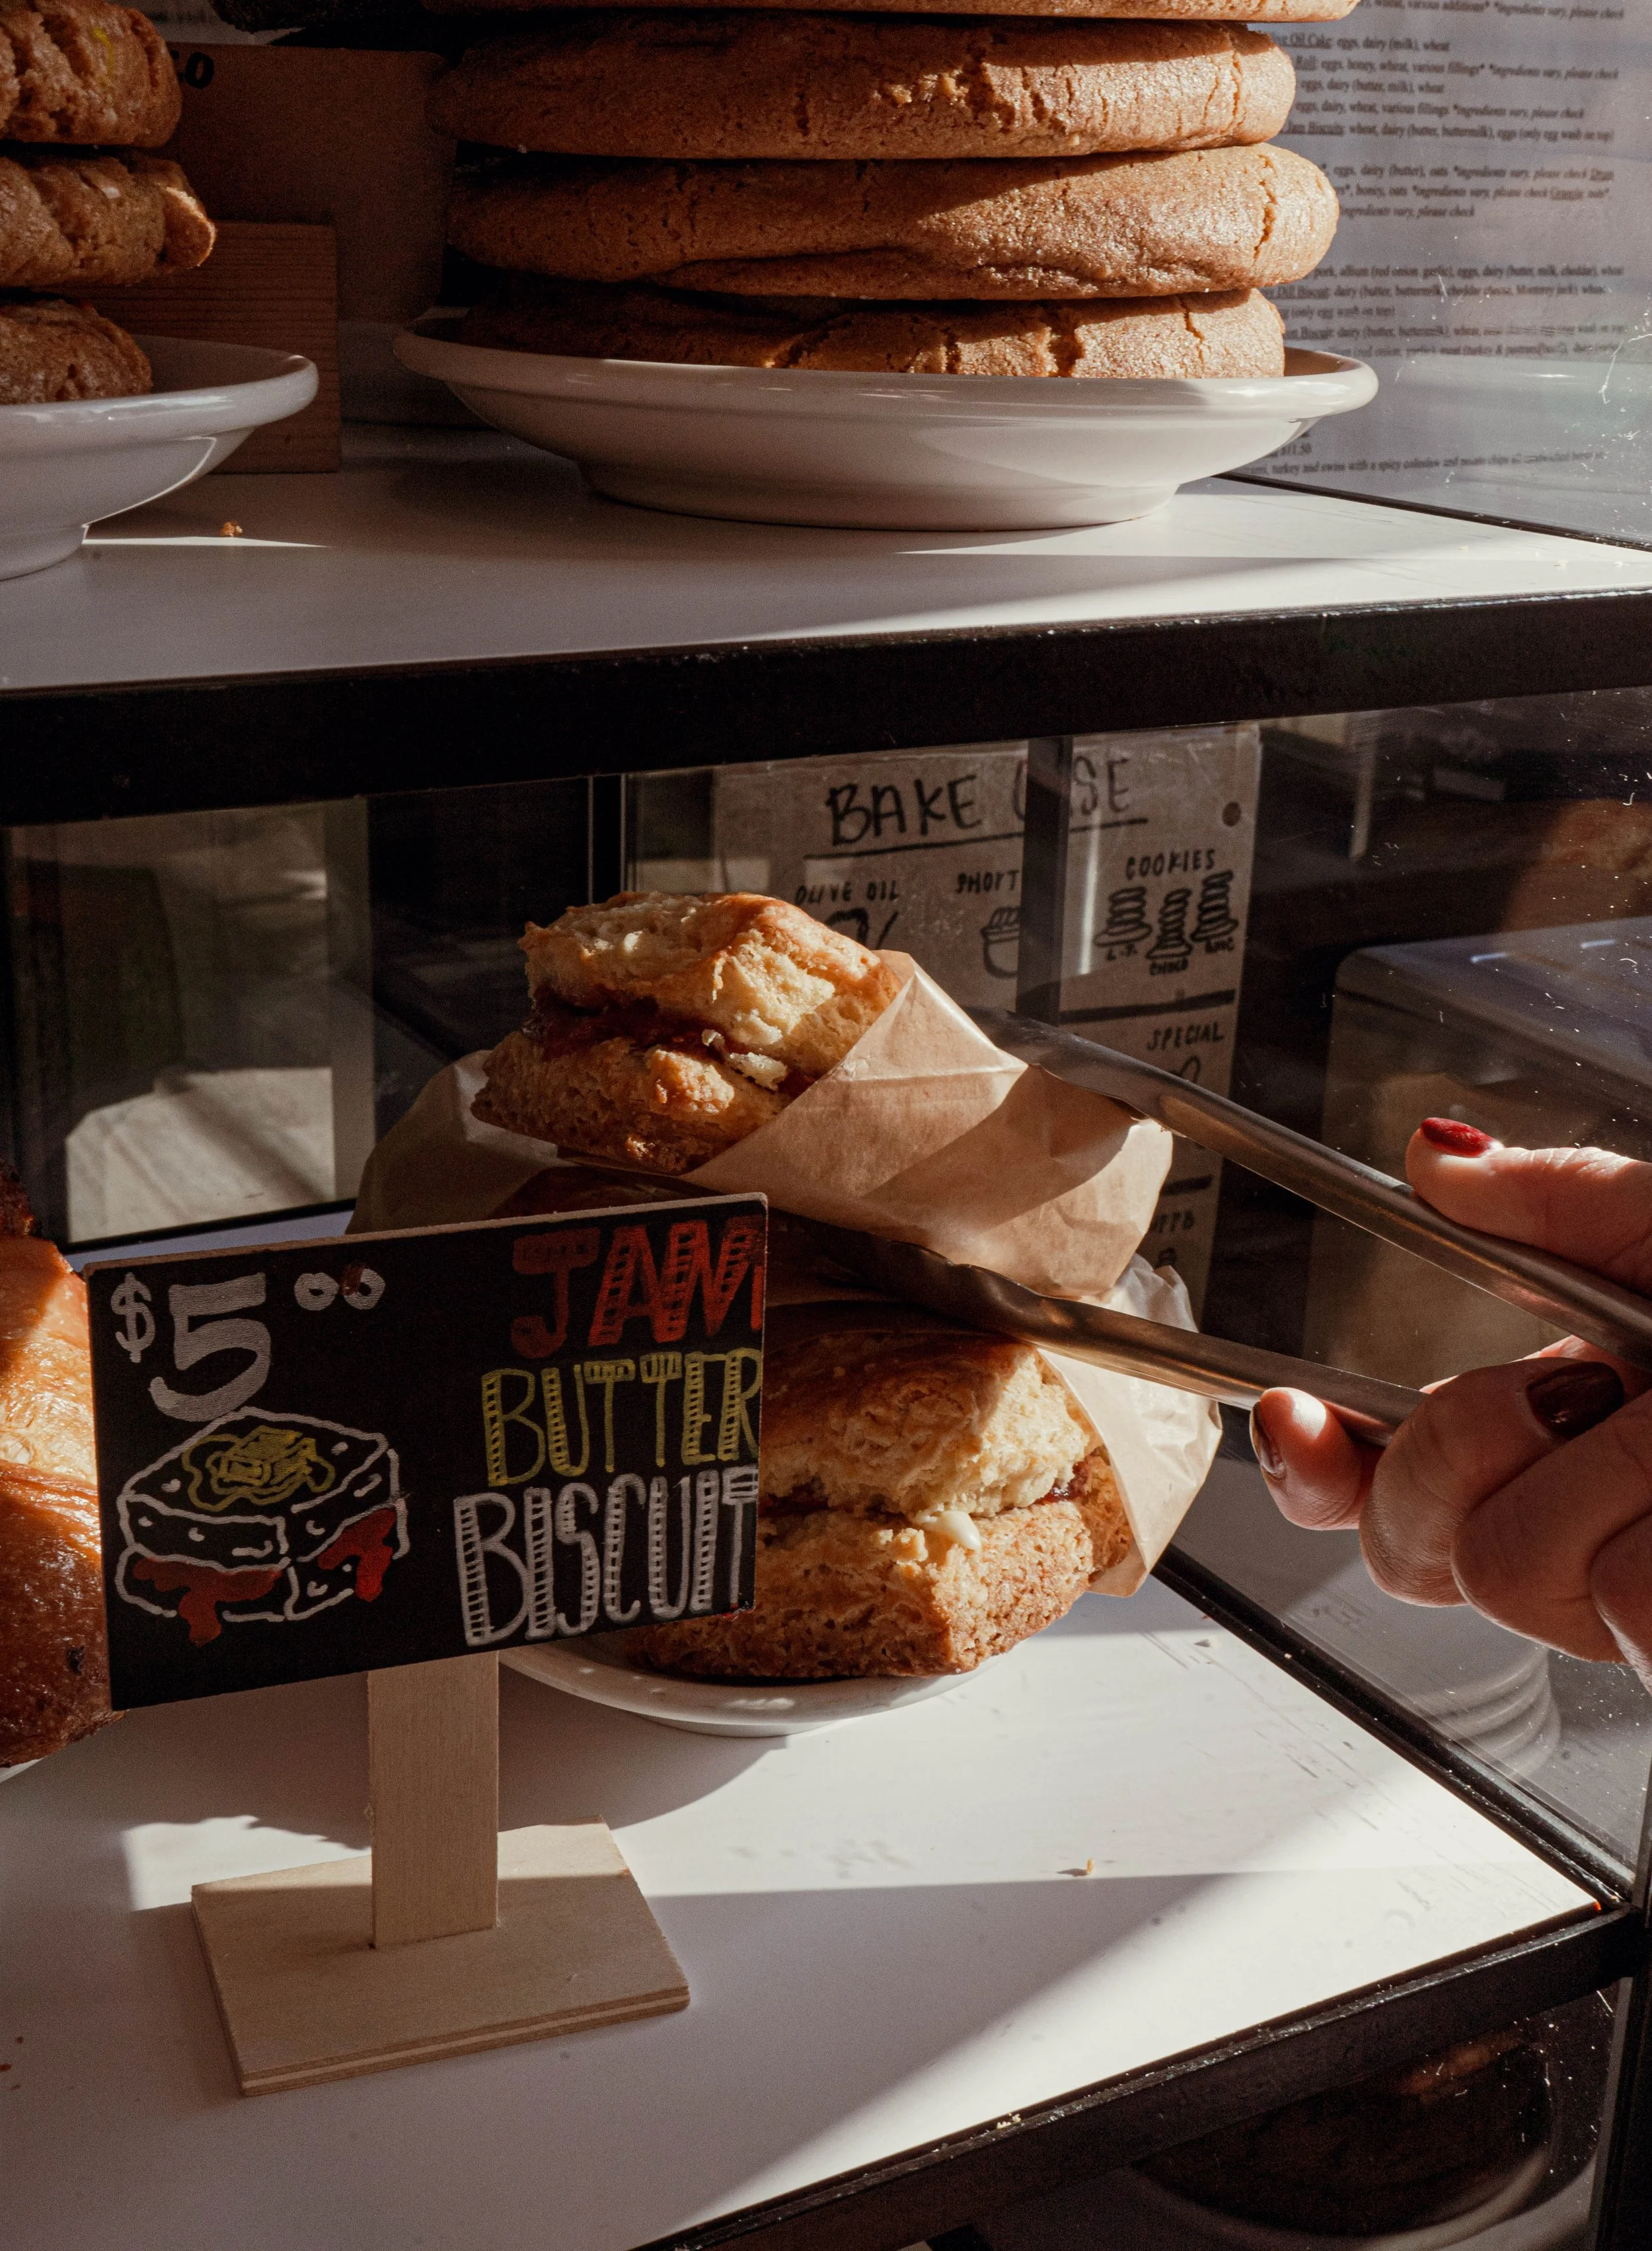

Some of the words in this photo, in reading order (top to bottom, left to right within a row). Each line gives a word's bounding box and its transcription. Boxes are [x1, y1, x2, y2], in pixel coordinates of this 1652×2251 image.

[825, 774, 981, 847] BAKE
[1013, 755, 1129, 821] CSE
[795, 882, 852, 905] OLIVE
[867, 880, 899, 901] OIL
[1126, 849, 1215, 880] COOKIES
[1147, 1022, 1224, 1050] SPECIAL
[510, 1214, 761, 1359] JAM
[481, 1347, 761, 1488] BUTTER
[453, 1465, 760, 1648] BISCUIT
